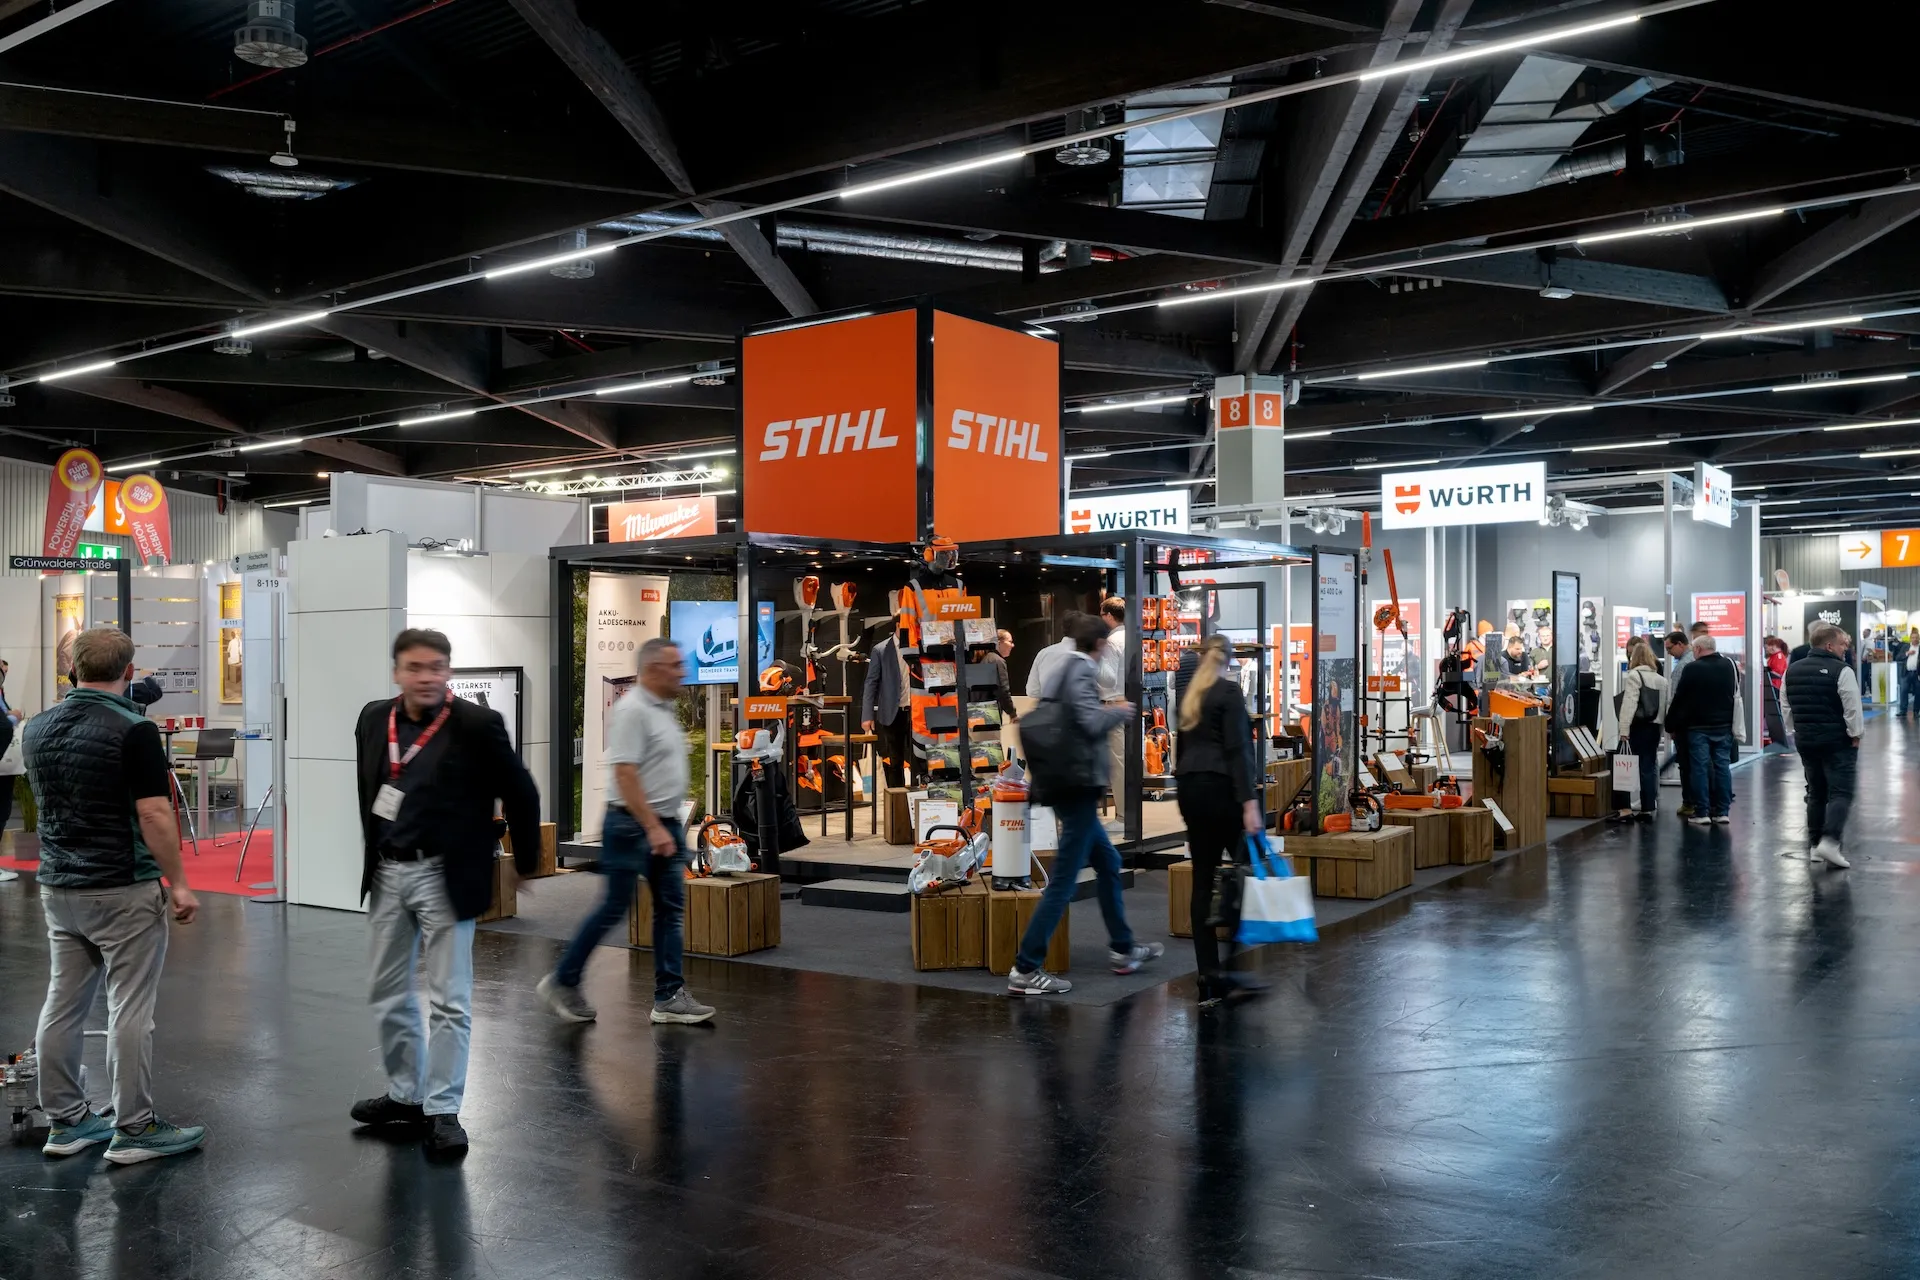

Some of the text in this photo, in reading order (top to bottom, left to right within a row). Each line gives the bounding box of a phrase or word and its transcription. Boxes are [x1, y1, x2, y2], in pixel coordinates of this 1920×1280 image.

[1229, 400, 1241, 421] 8
[1263, 400, 1273, 420] 8
[759, 407, 898, 462] STIHL
[948, 409, 1048, 462] STIHL
[68, 462, 88, 476] FLUID
[73, 469, 90, 481] FILM
[48, 502, 75, 550] POWERFUL
[620, 503, 700, 541] Milwaukee
[1896, 535, 1910, 560] 7
[14, 558, 111, 569] Grünwalder-Straße
[257, 579, 279, 587] 8-119
[940, 603, 976, 613] STIHL
[1818, 609, 1841, 618] vinci
[457, 681, 492, 689] STÄRKSTE
[749, 703, 783, 713] STIHL
